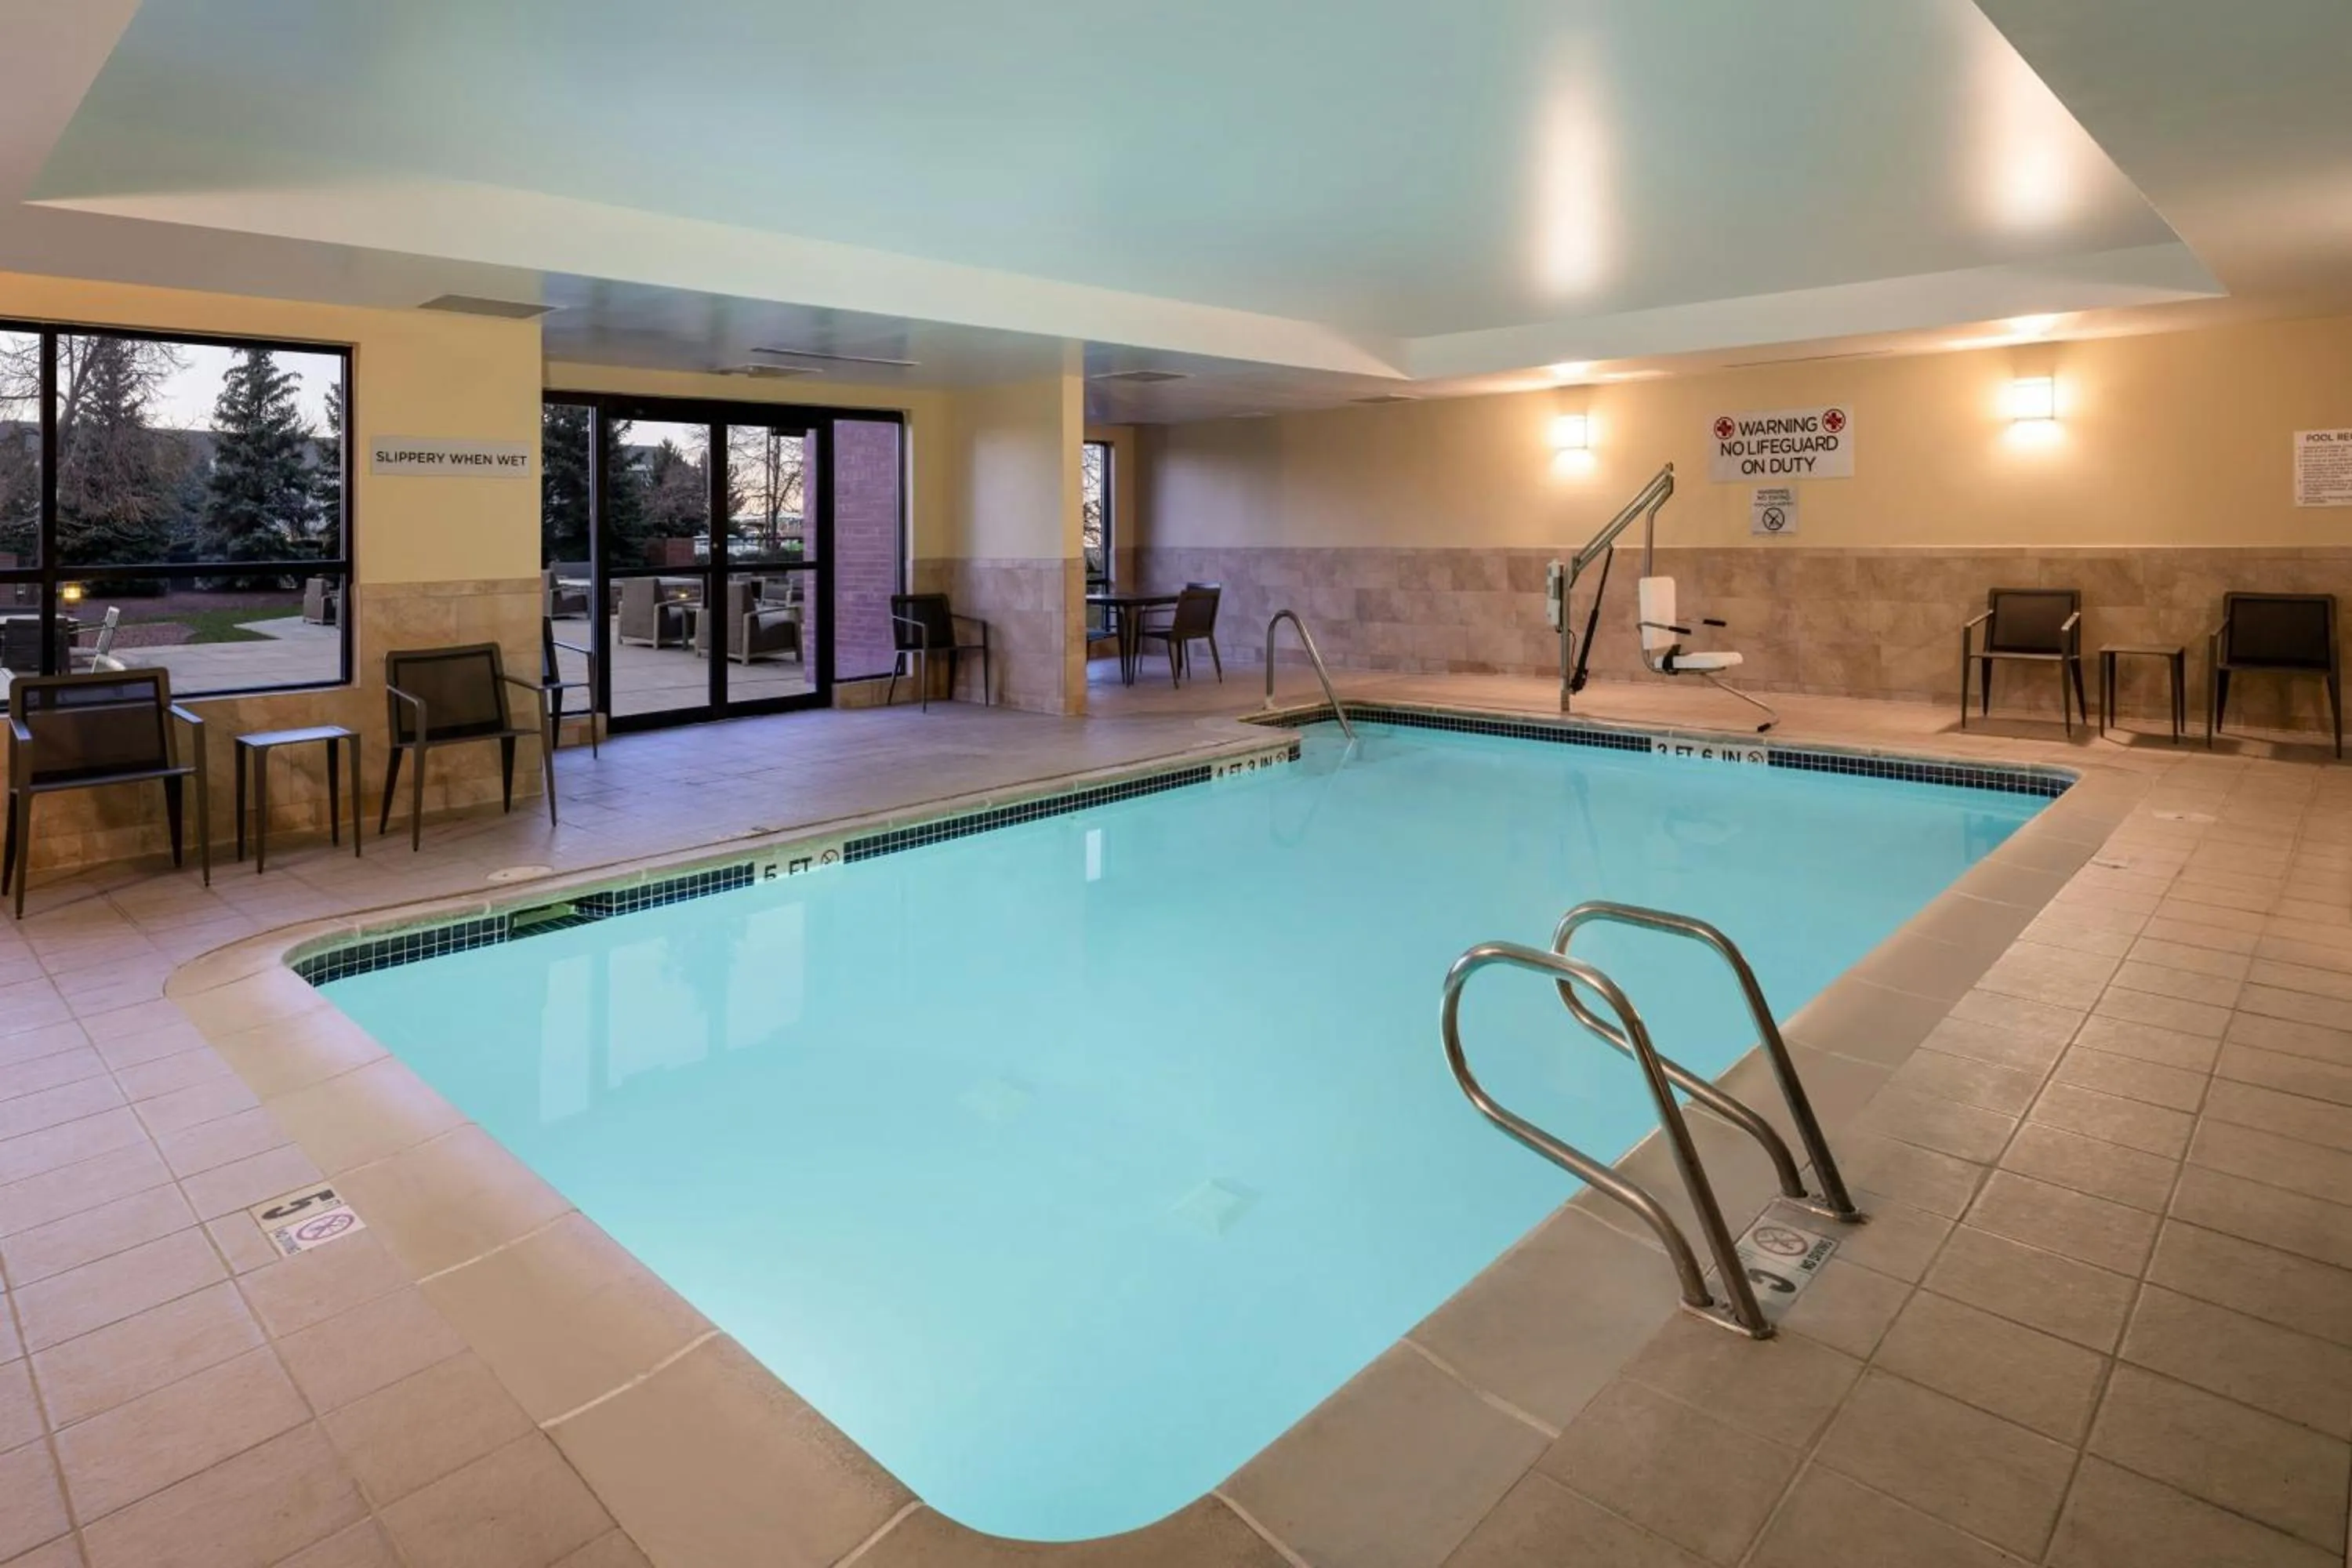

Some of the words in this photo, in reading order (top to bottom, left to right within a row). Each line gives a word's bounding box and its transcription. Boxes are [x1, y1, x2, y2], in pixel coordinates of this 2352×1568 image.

[1738, 416, 1819, 437] WARNING
[1720, 441, 1744, 456] NO
[1748, 436, 1839, 456] LIFEGUARD
[2306, 433, 2334, 442] POOL
[376, 451, 445, 464] SLIPPERY
[449, 453, 493, 466] WHEN
[496, 454, 528, 466] WET
[1741, 459, 1766, 474] ON
[1769, 456, 1817, 474] DUTY
[1675, 746, 1694, 757] FT
[1722, 750, 1741, 763] IN
[1229, 763, 1242, 775] FT
[1261, 756, 1272, 768] IN
[789, 856, 812, 875] FT
[261, 1189, 336, 1220] 5
[1799, 1258, 1817, 1270] NO
